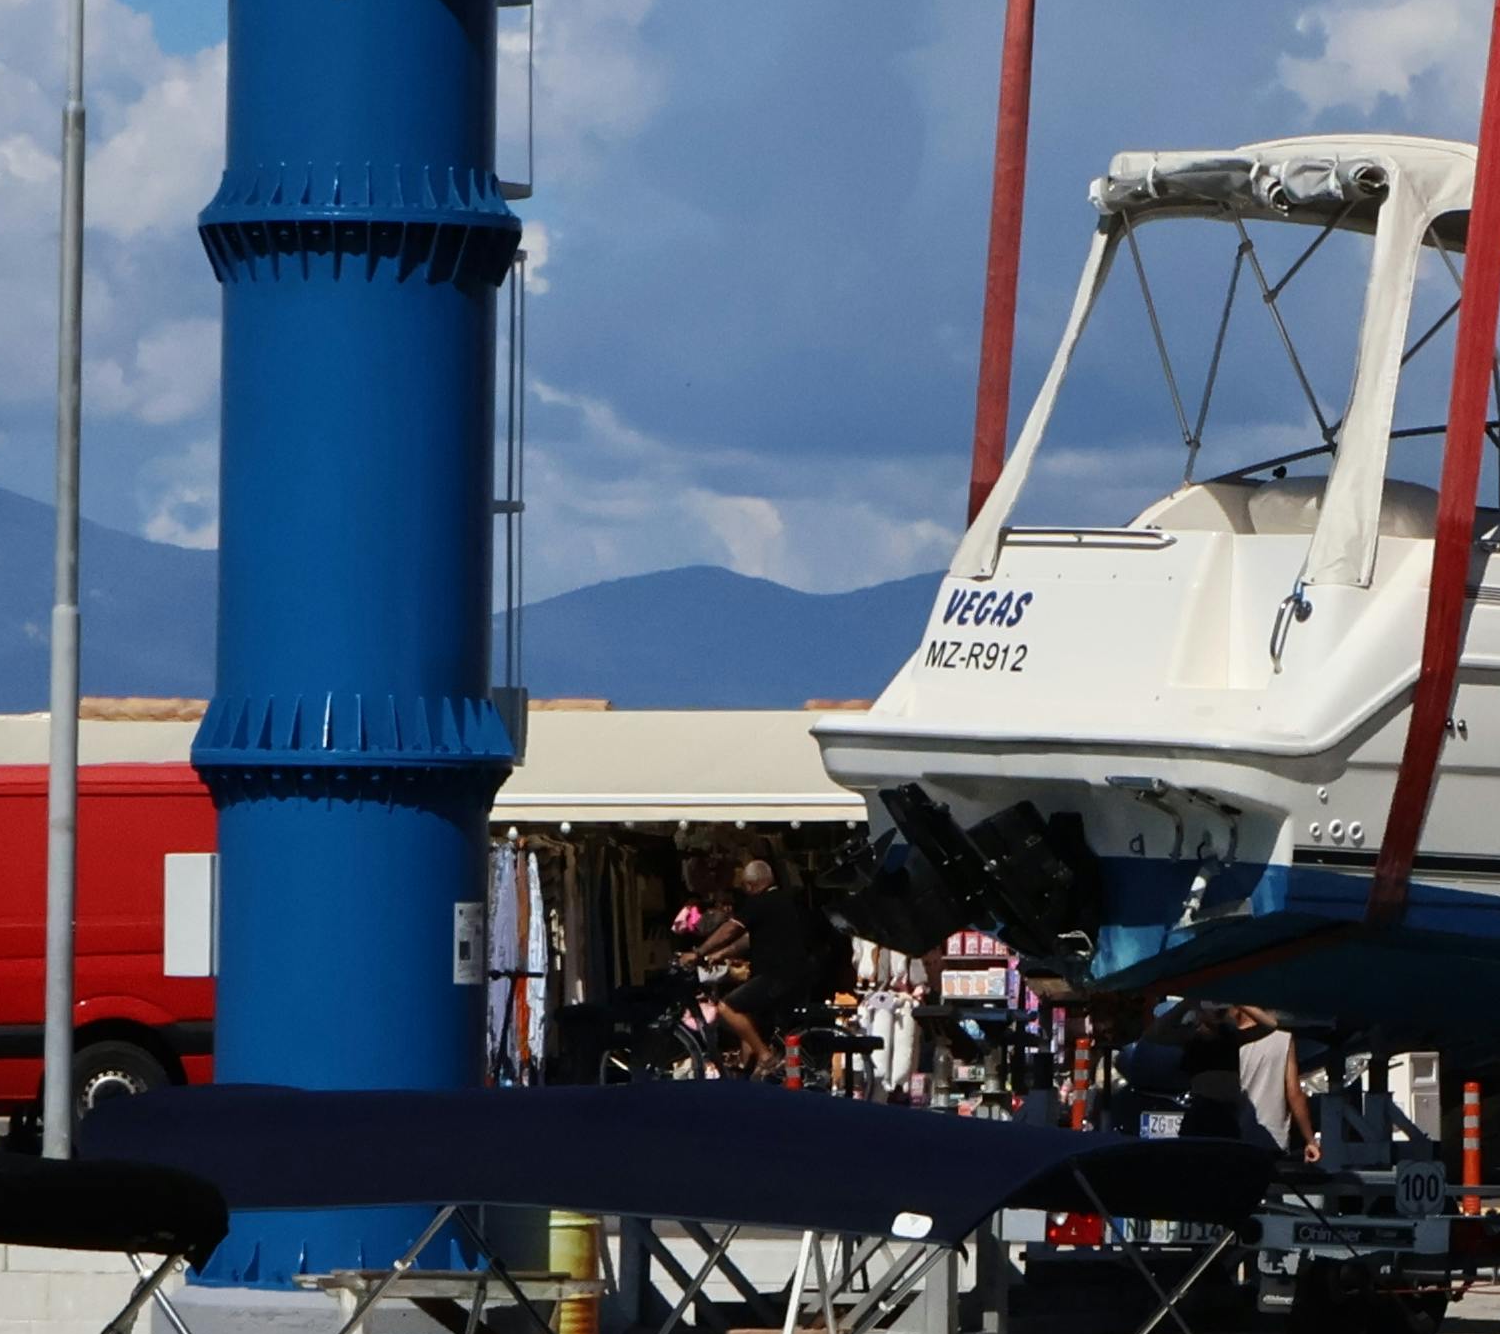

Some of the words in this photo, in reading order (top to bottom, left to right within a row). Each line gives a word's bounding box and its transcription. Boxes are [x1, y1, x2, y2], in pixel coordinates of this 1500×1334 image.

[943, 588, 1033, 628] VEGAS
[925, 639, 1029, 673] MZ-R912
[1401, 1174, 1441, 1202] 100
